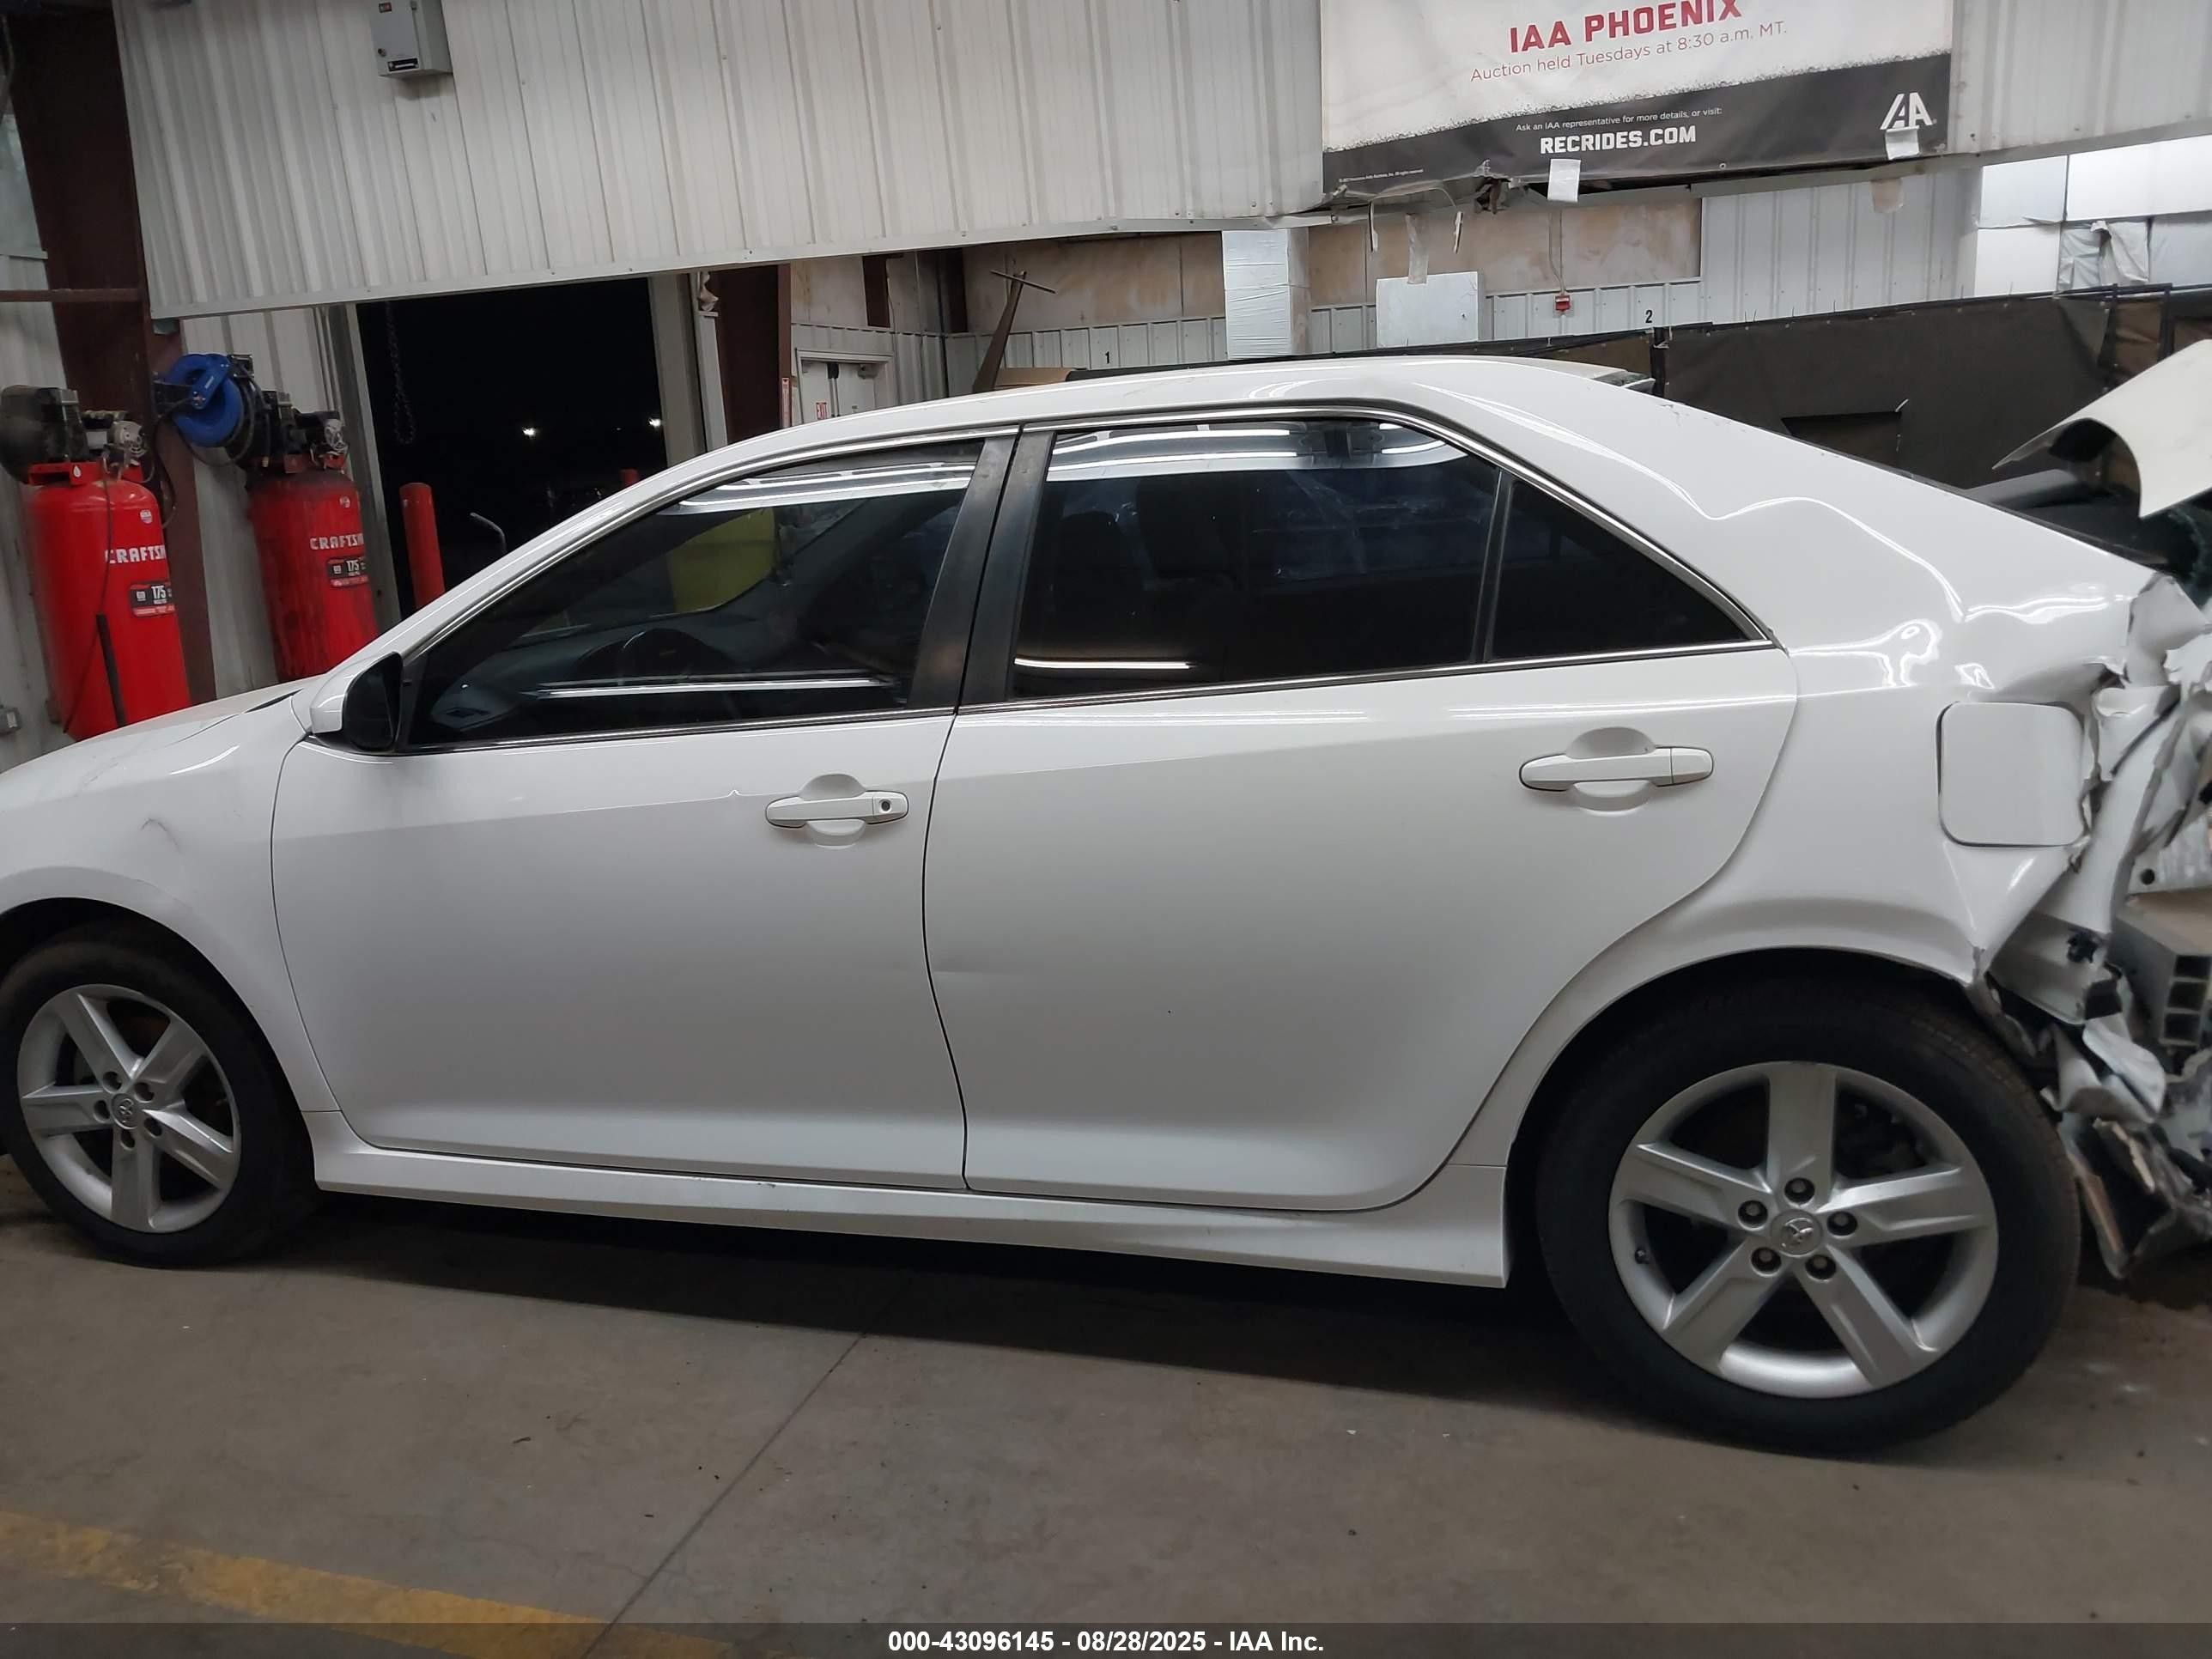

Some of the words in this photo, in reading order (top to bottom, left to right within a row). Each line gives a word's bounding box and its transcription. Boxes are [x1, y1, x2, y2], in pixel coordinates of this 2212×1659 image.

[1510, 21, 1571, 53] IAA
[1584, 0, 1742, 42] PHOENIX
[1470, 64, 1532, 82] Auction
[1537, 54, 1571, 72] held
[1577, 43, 1651, 67] Tuesdays
[1656, 40, 1673, 55] at
[1677, 33, 1715, 51] 8:30
[1720, 29, 1754, 44] a.m.
[1759, 21, 1788, 38] MT.
[1562, 117, 1621, 129] representative
[1622, 114, 1635, 124] for
[1636, 113, 1658, 122] more
[1540, 125, 1697, 155] RECRIDES.COM
[1645, 309, 1653, 324] 2
[1104, 350, 1110, 364] 1
[151, 585, 167, 599] 175
